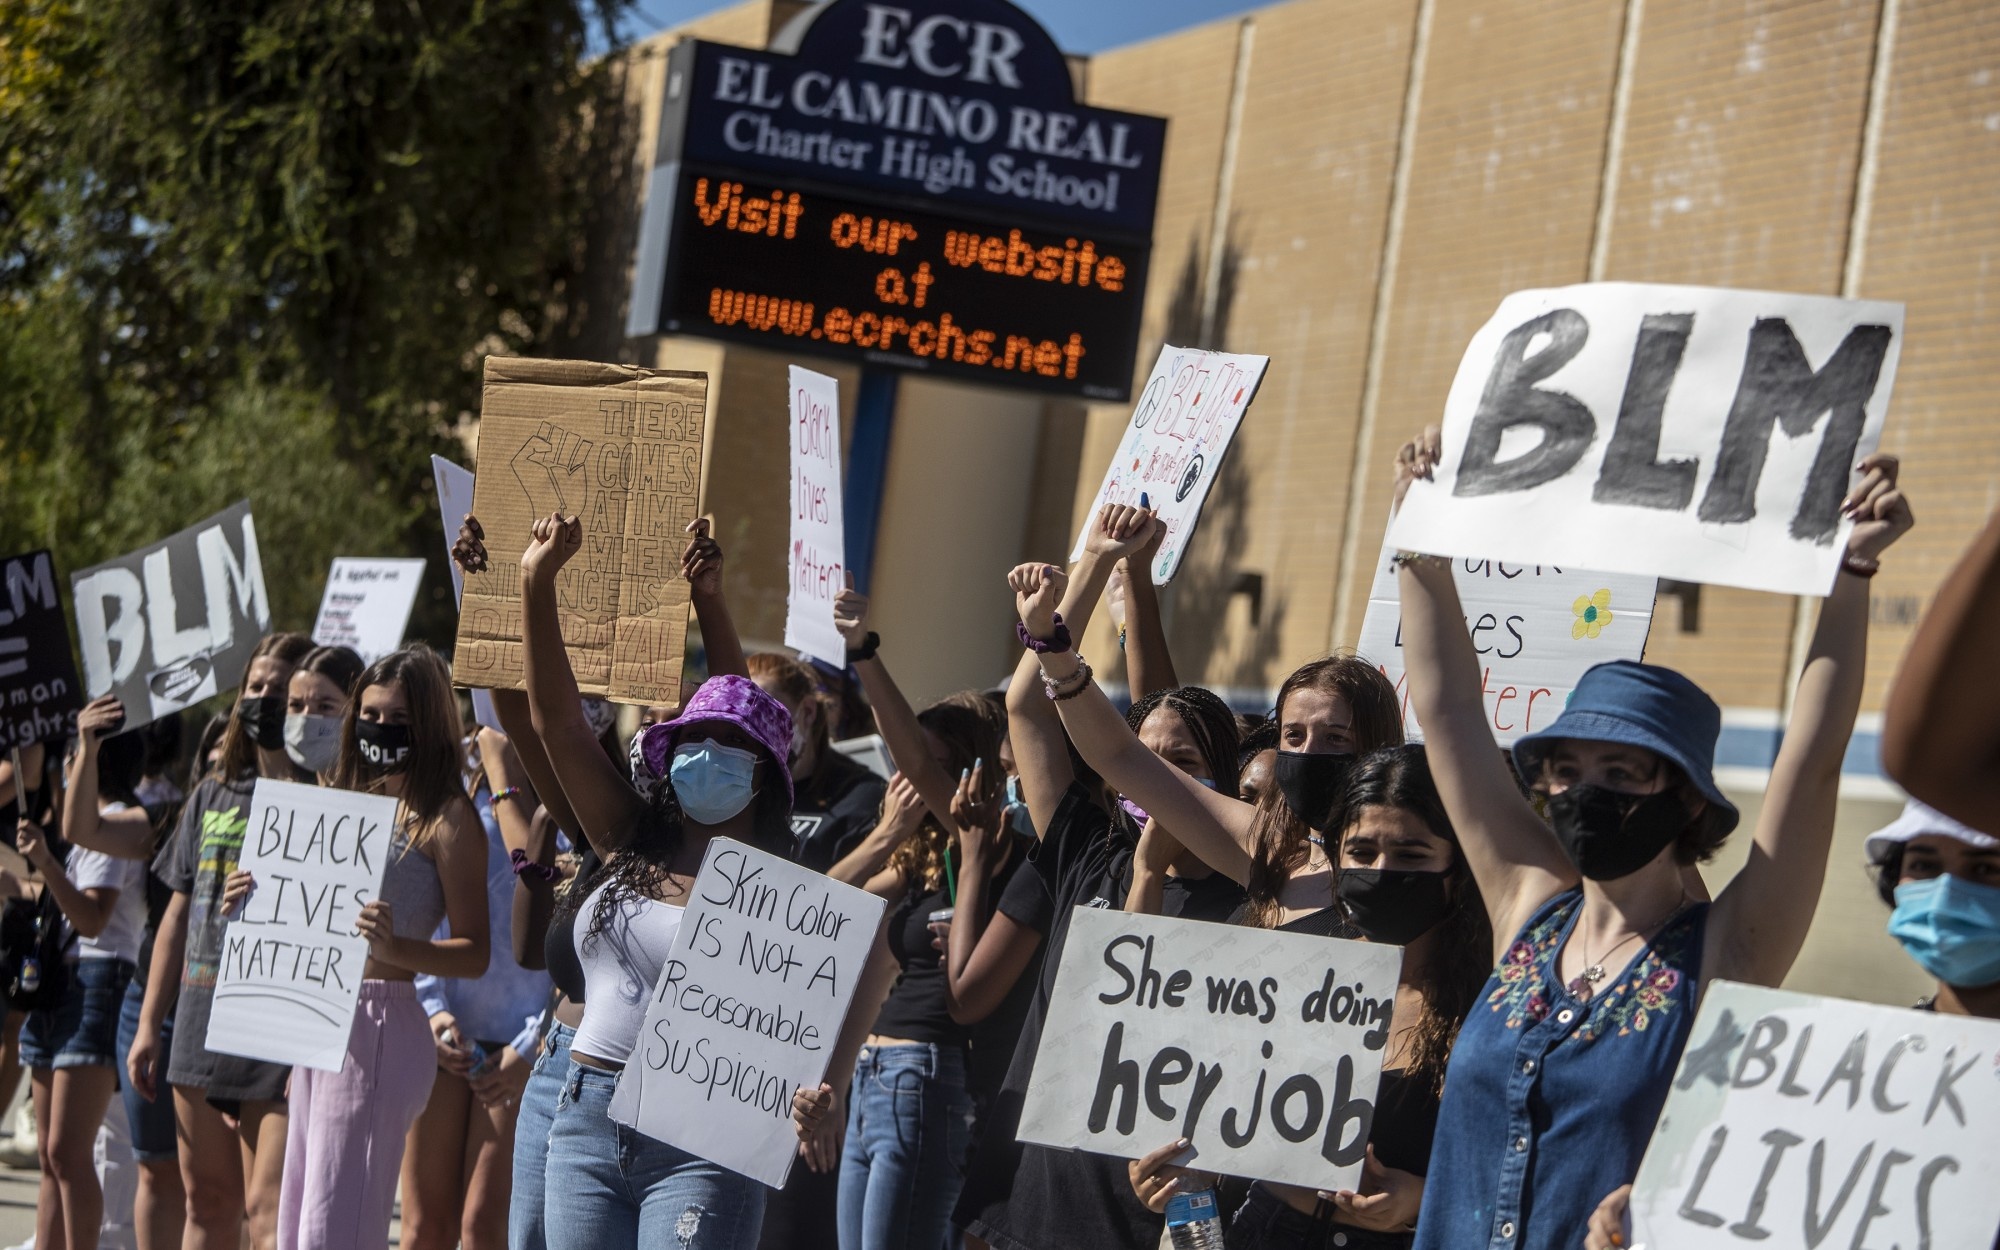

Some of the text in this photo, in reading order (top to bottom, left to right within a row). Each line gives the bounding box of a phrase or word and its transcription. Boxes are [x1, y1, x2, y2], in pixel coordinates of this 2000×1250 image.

[858, 3, 1023, 89] ECR
[714, 58, 1143, 168] EL CAMINO REAL
[723, 111, 1119, 213] Charter High School
[694, 177, 1126, 292] Visit our website
[875, 261, 934, 308] at
[708, 287, 1086, 380] www.ecrchs.net
[599, 399, 704, 443] THERE
[798, 388, 833, 469] Black
[1154, 362, 1244, 445] BLM
[1451, 307, 1893, 548] BLM
[597, 442, 698, 495] COMES
[475, 560, 662, 618] SILNCE IS
[587, 534, 687, 581] WHEN
[74, 512, 271, 700] BLM
[466, 608, 680, 686] BERAYAL
[0, 677, 67, 710] man
[257, 805, 378, 876] BLACK
[241, 874, 369, 938] LIVES
[786, 883, 852, 941] Color
[224, 935, 352, 994] MATTER.
[689, 912, 723, 958] IS
[806, 955, 837, 998] A
[1098, 934, 1193, 1009] She
[1205, 974, 1278, 1024] was
[1301, 967, 1394, 1051] doing
[658, 959, 822, 1051] Reasonable
[1087, 1020, 1375, 1167] her job
[1731, 1014, 1982, 1128] BLACK
[1677, 1123, 1961, 1250] LIVES
